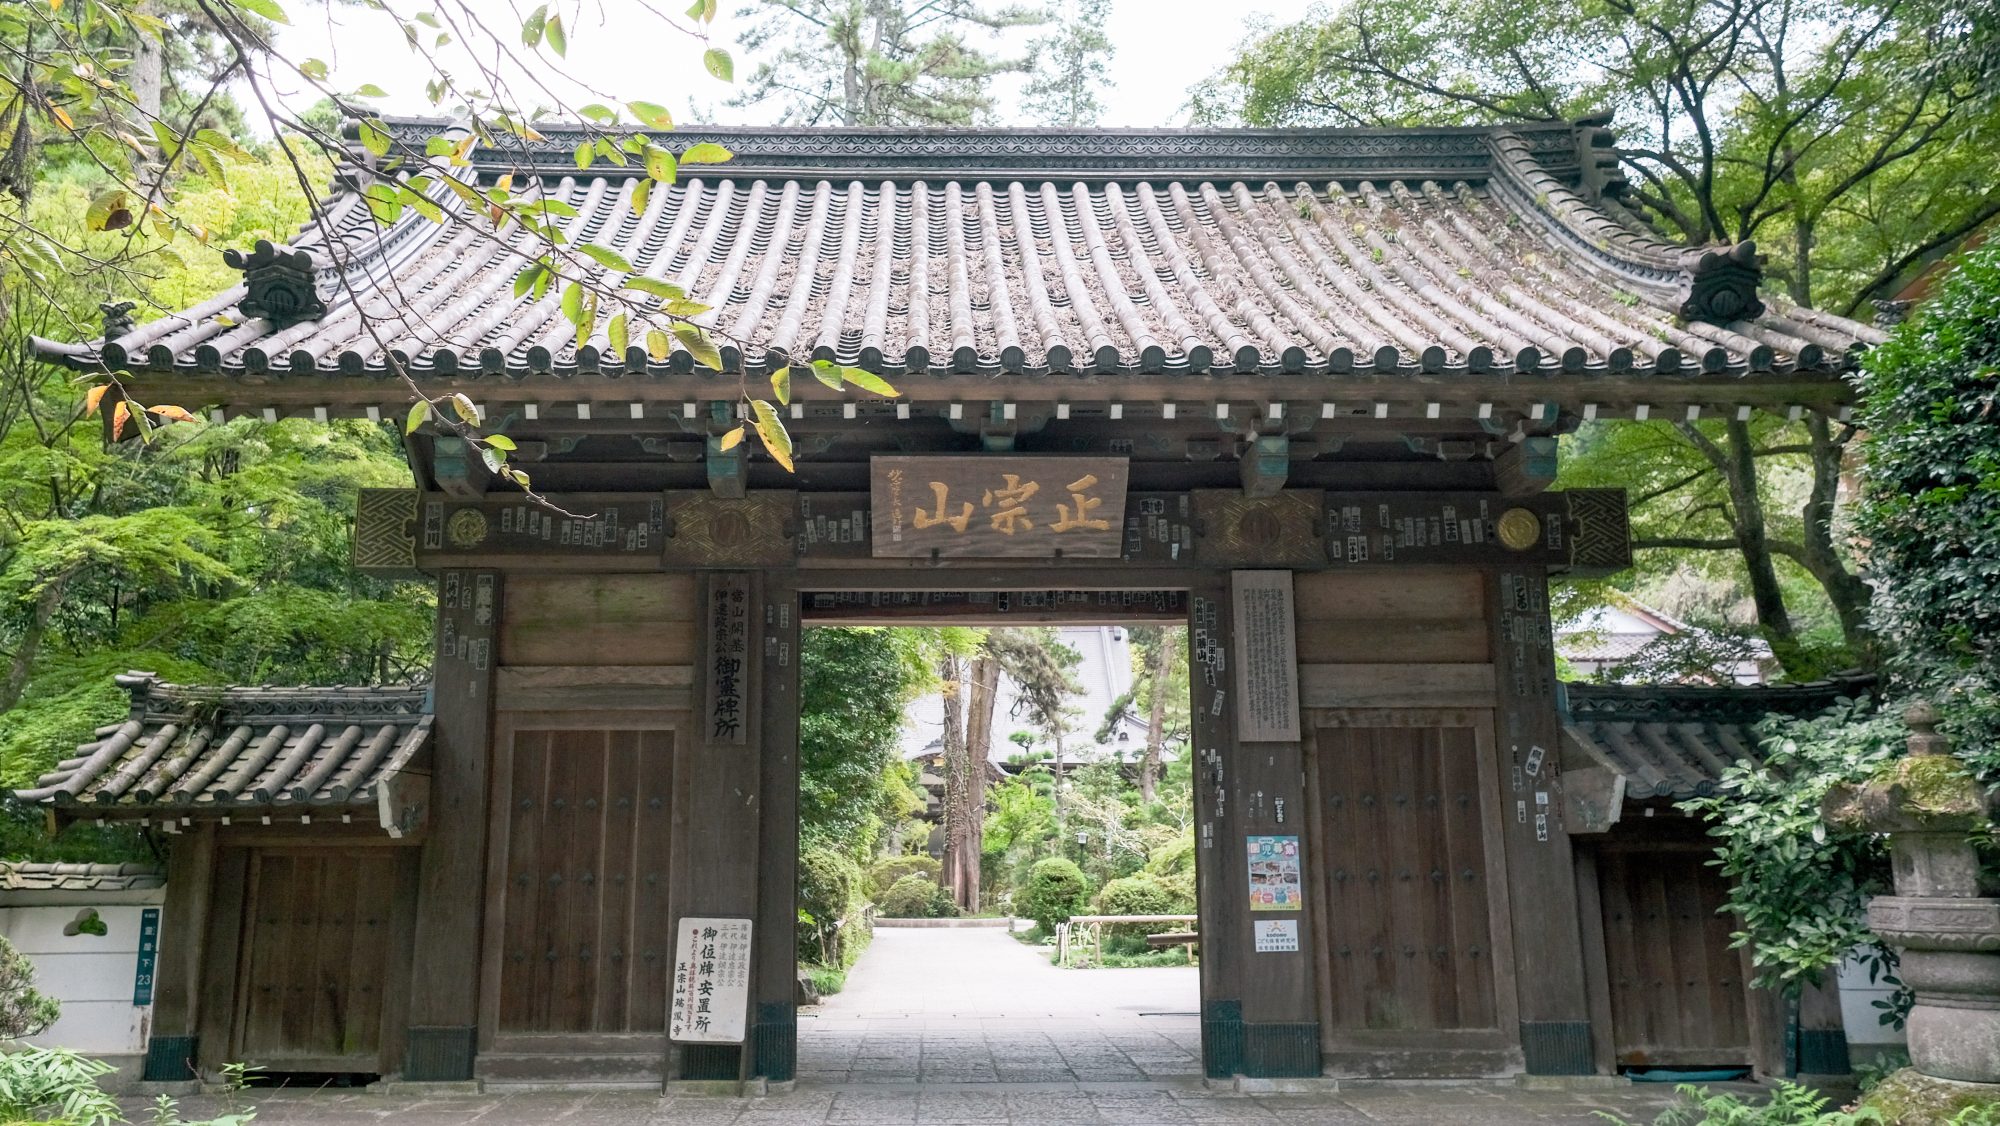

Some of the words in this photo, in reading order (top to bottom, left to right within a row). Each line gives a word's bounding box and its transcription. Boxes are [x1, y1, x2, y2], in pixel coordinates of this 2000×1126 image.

[913, 474, 1110, 536] 正宗山
[137, 975, 151, 985] 23
[672, 962, 687, 1036] 正宗山瑞鳳寺
[695, 927, 718, 1033] 御位牌安置所
